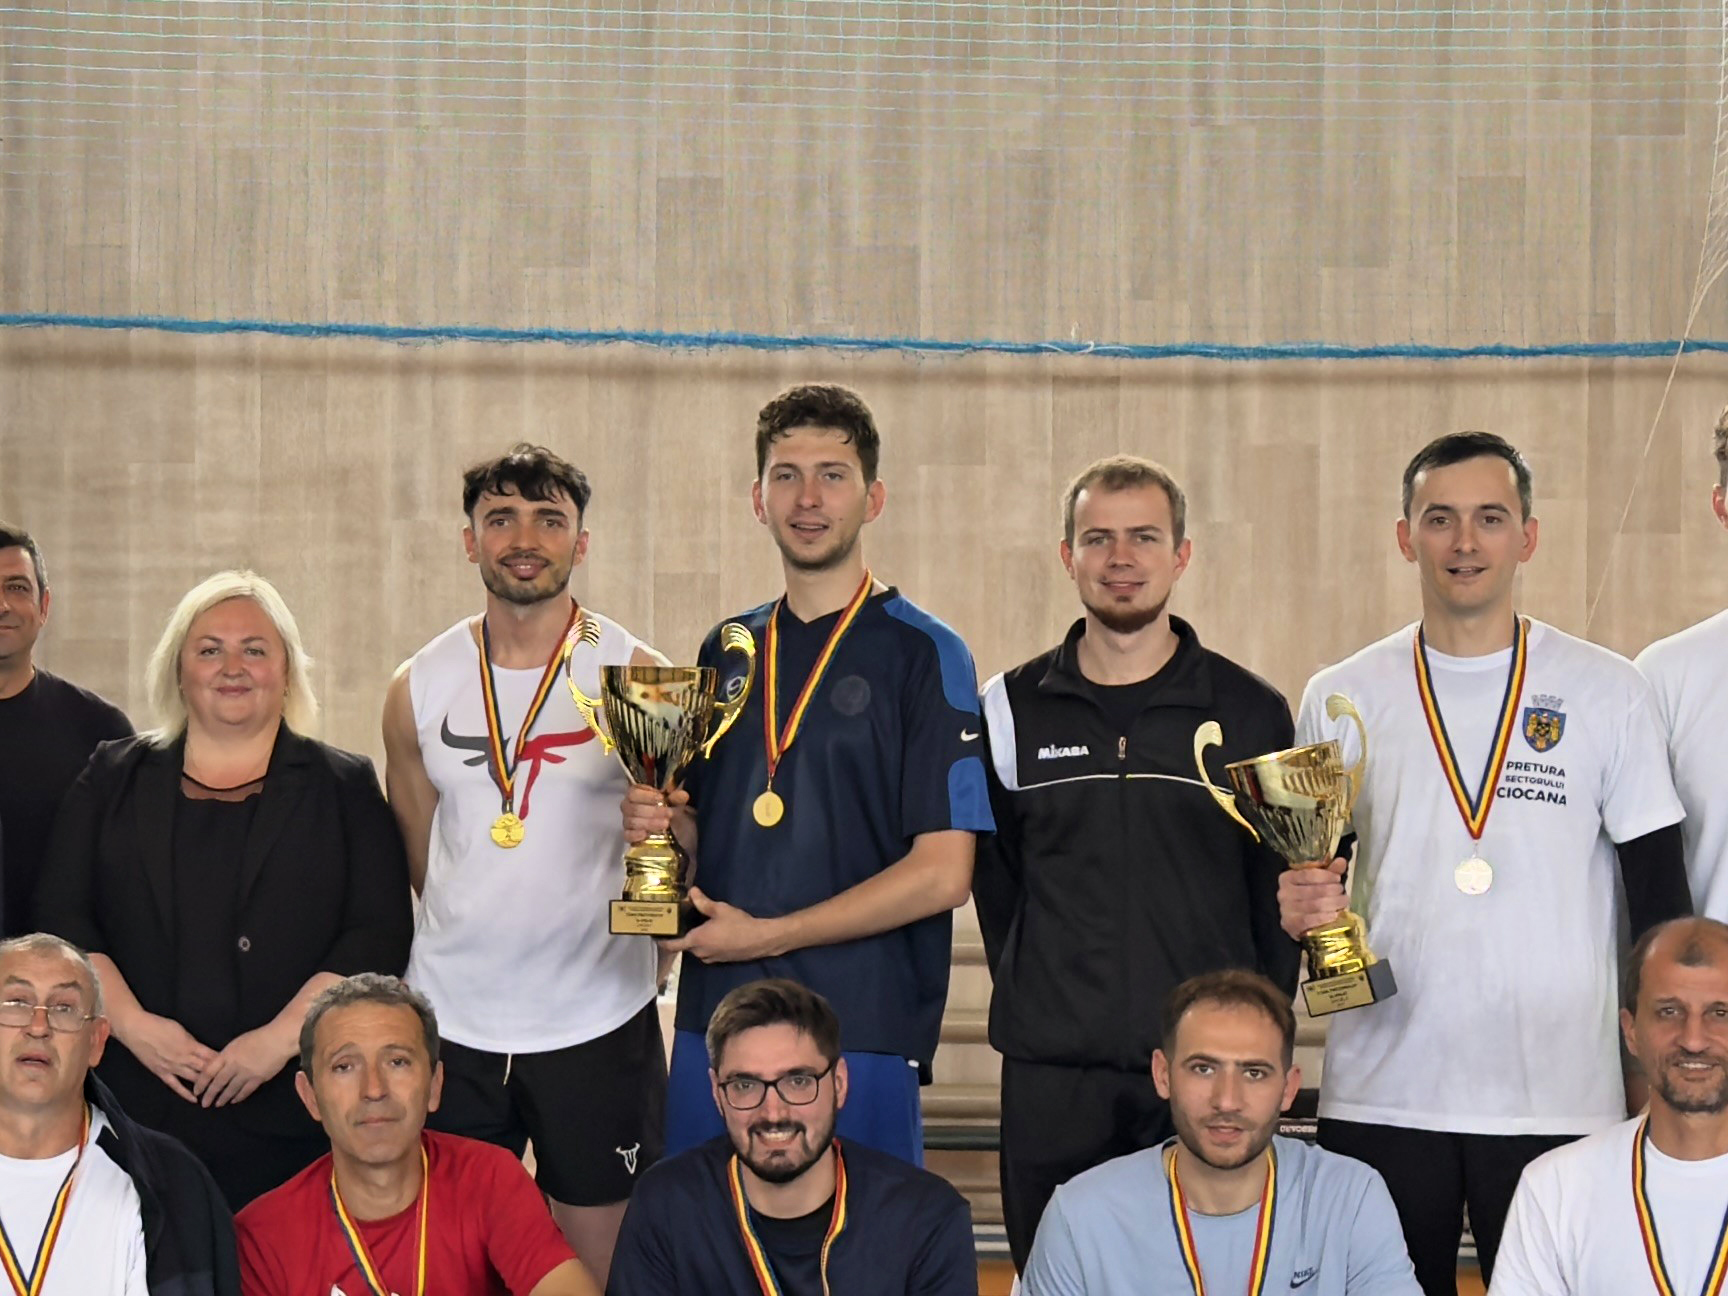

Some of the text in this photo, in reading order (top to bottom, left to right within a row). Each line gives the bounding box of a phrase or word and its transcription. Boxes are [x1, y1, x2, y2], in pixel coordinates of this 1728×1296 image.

[1506, 761, 1566, 777] PRETURA
[1505, 775, 1565, 789] SECTORULUI
[1496, 786, 1567, 805] CIOCANA
